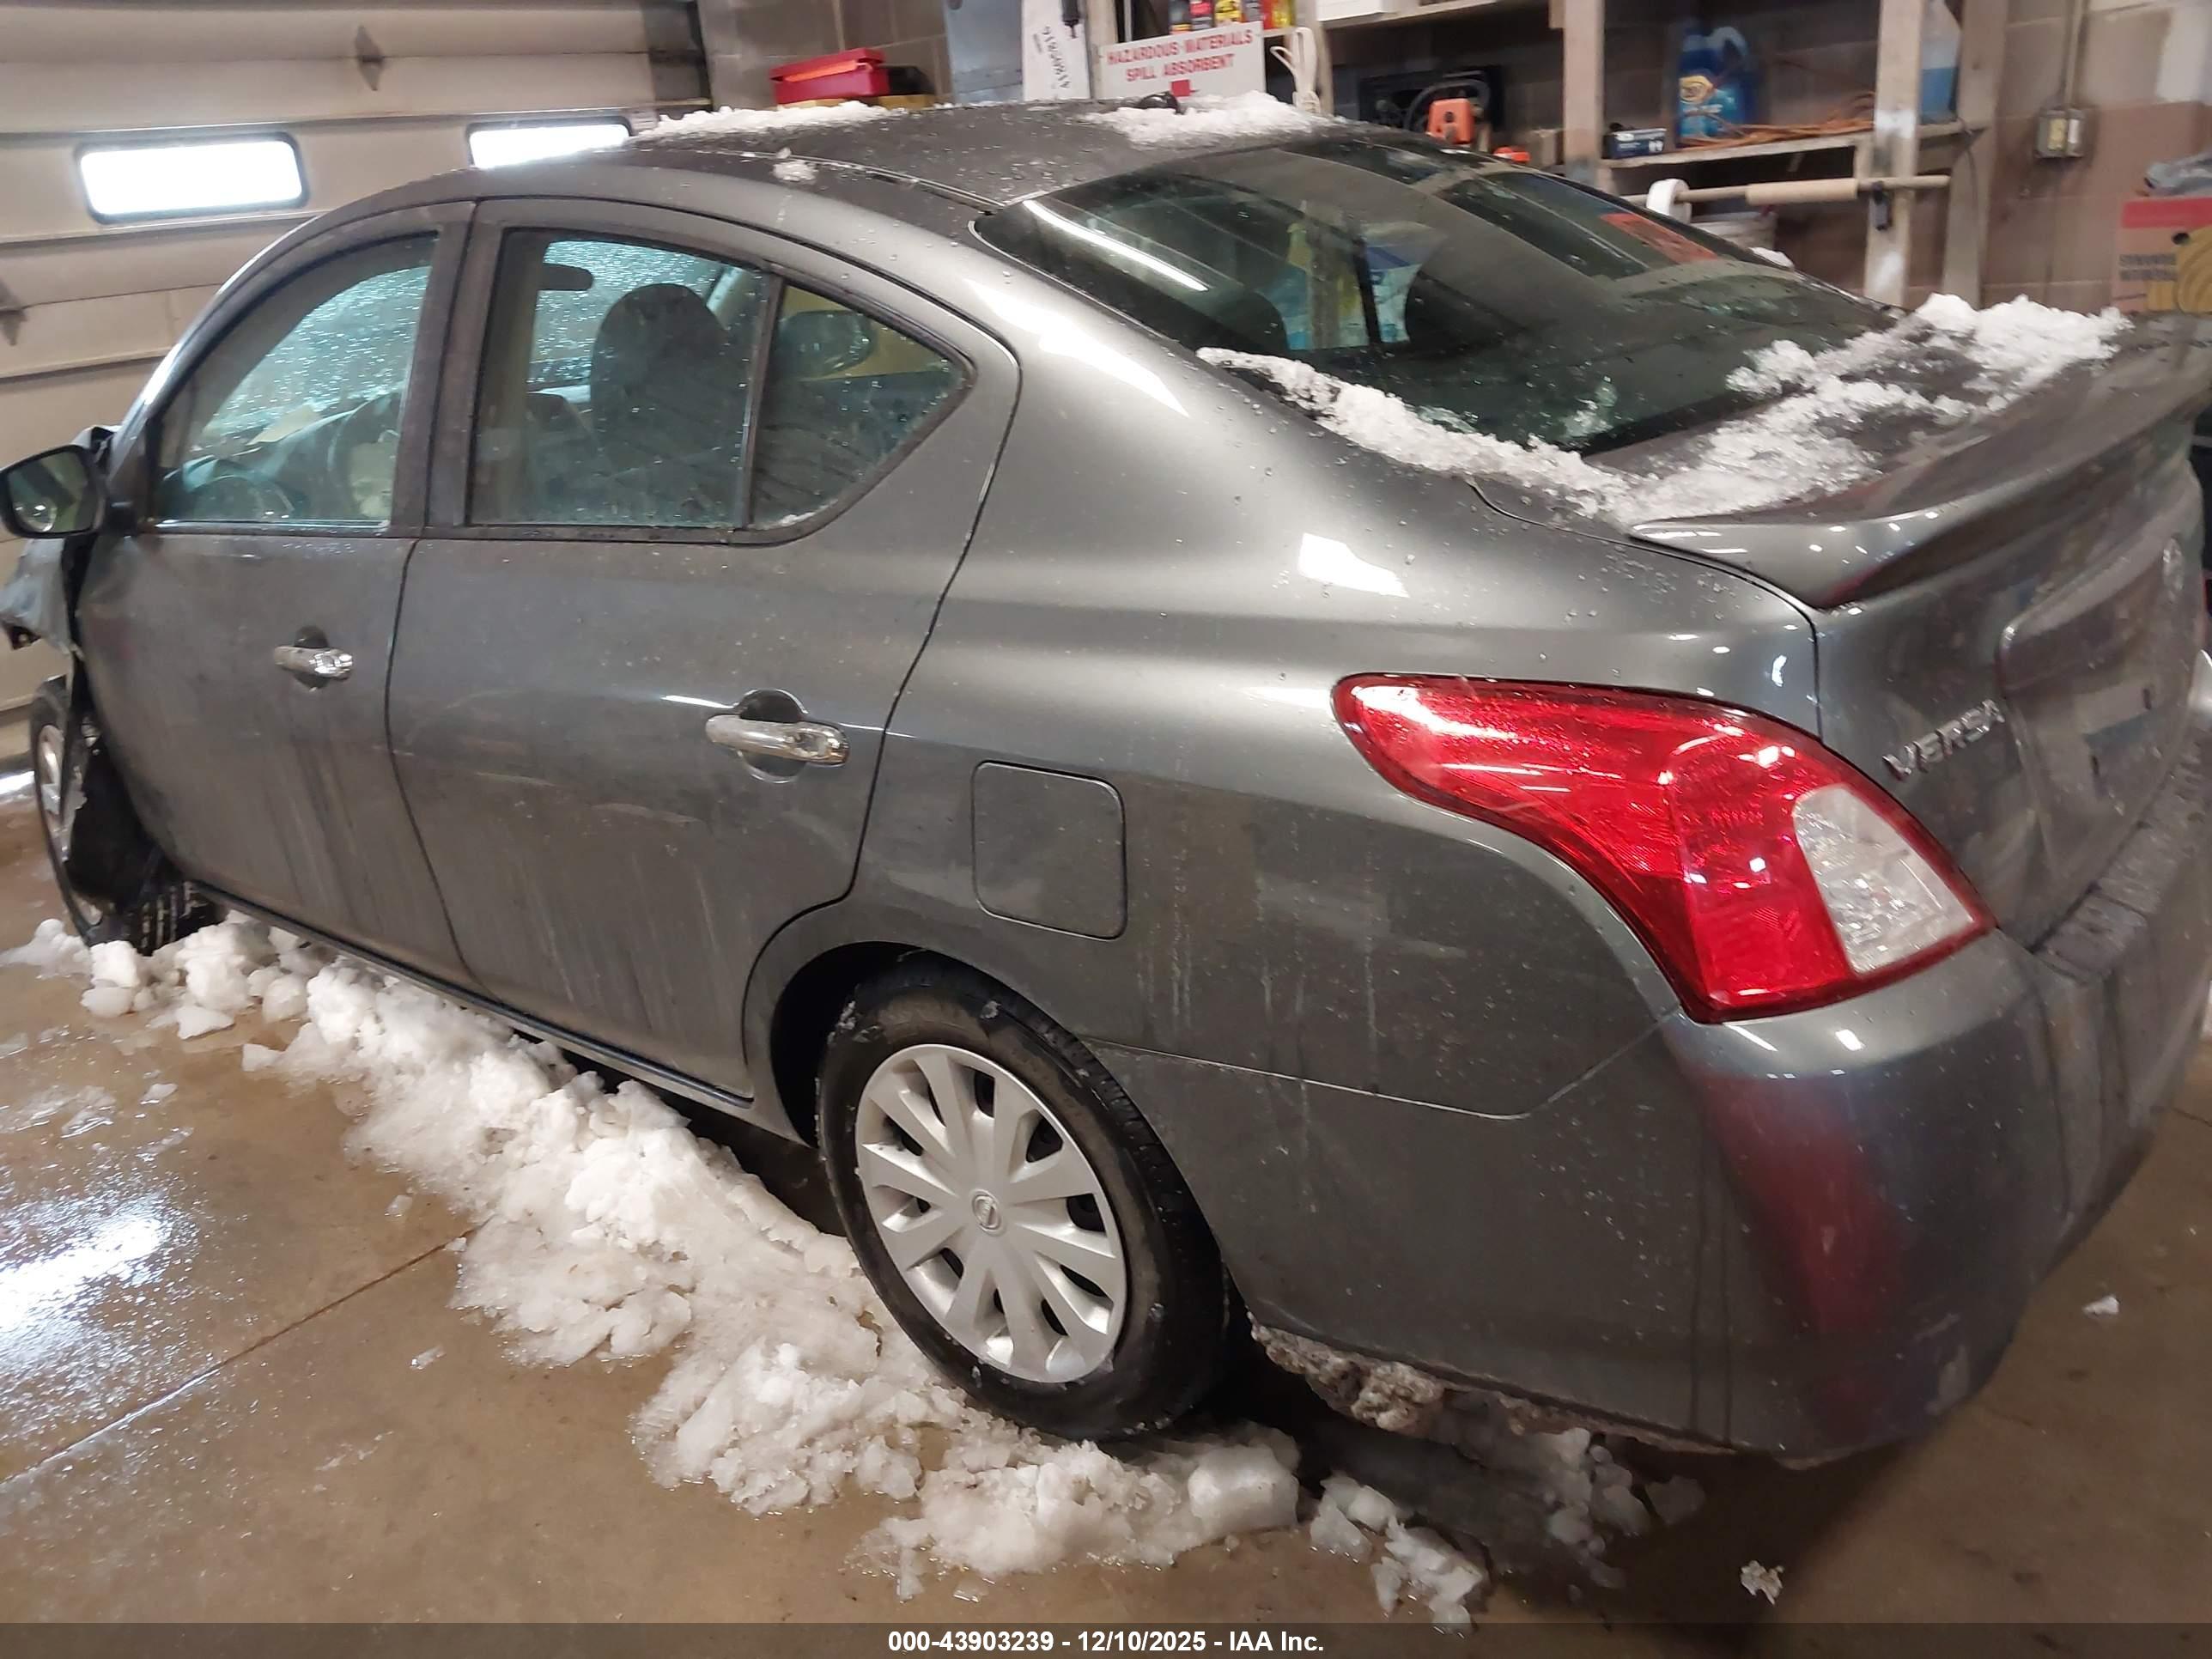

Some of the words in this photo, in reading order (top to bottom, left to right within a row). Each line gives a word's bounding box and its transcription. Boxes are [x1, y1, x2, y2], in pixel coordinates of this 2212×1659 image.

[1107, 42, 1179, 65] HAZARDOUS
[1184, 29, 1253, 53] MATERIALS
[1126, 66, 1157, 82] SPILL
[1163, 53, 1235, 76] ABSORBENT
[1882, 699, 2006, 781] VERSA
